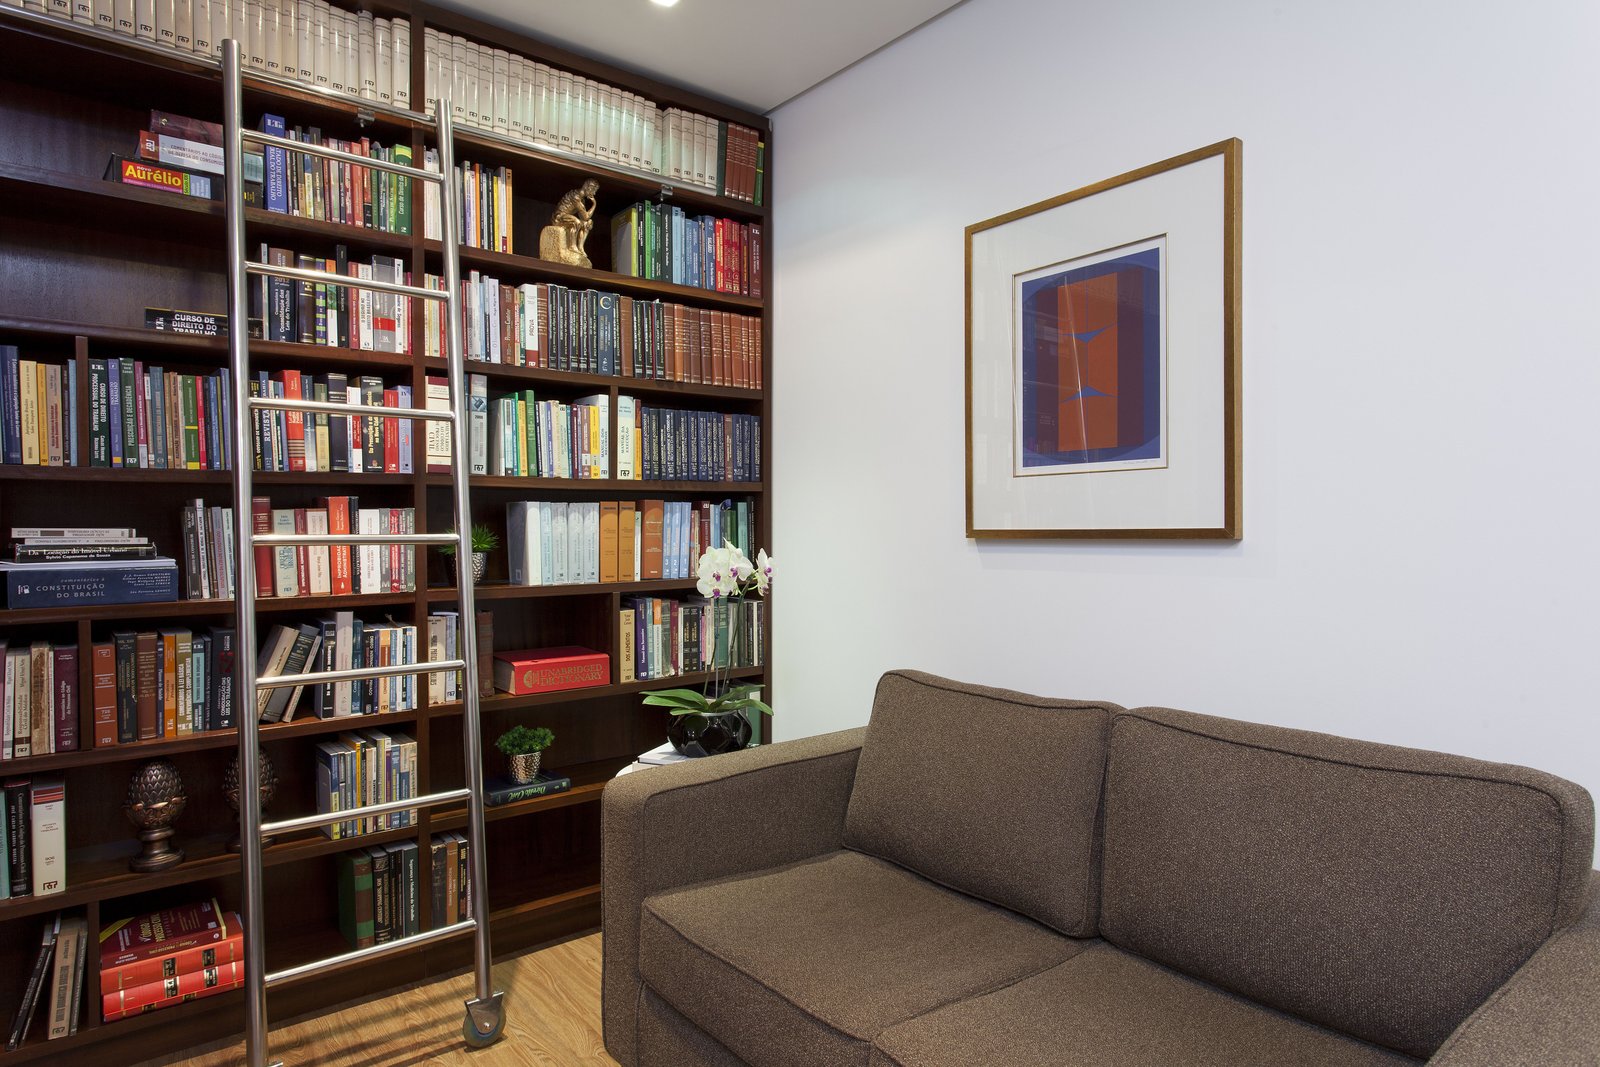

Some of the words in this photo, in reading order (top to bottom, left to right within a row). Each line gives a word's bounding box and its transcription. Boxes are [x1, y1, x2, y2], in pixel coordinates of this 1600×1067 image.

[125, 165, 182, 187] Aurélio
[172, 319, 201, 331] DIREITO
[201, 322, 218, 332] DO
[175, 313, 200, 324] CURSO
[201, 316, 215, 325] DE
[125, 385, 133, 413] DECADÊNCIA
[126, 418, 135, 446] PRESCRIÇÃO
[263, 409, 271, 442] REVISTA
[43, 548, 69, 557] Locação
[36, 583, 105, 592] CONSTITUIÇÃO
[539, 663, 603, 678] UNABRIDGED
[539, 671, 603, 687] DICTIONARY
[507, 791, 525, 802] Civil
[525, 786, 546, 795] Direito
